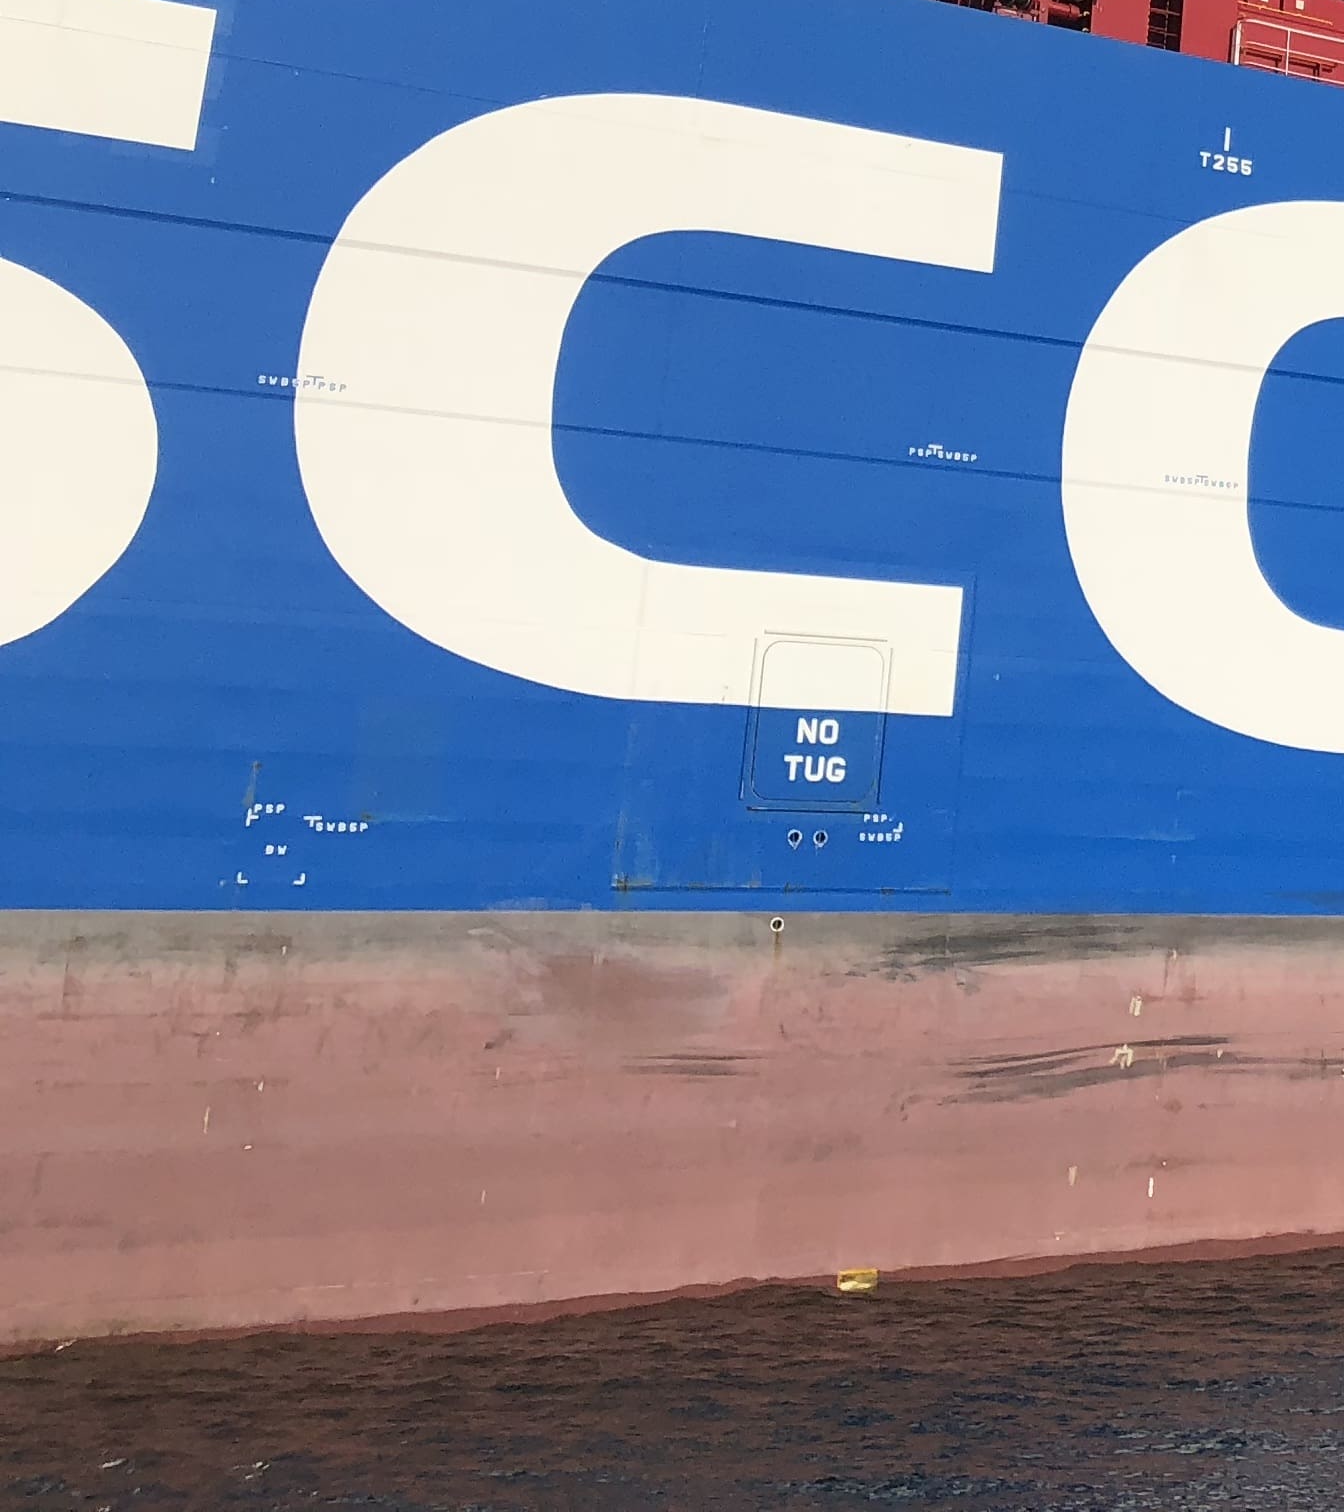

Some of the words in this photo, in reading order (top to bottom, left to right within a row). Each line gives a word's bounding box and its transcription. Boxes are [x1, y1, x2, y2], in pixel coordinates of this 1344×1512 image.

[1199, 151, 1253, 177] T255
[796, 717, 840, 745] NO
[784, 754, 847, 783] TUG
